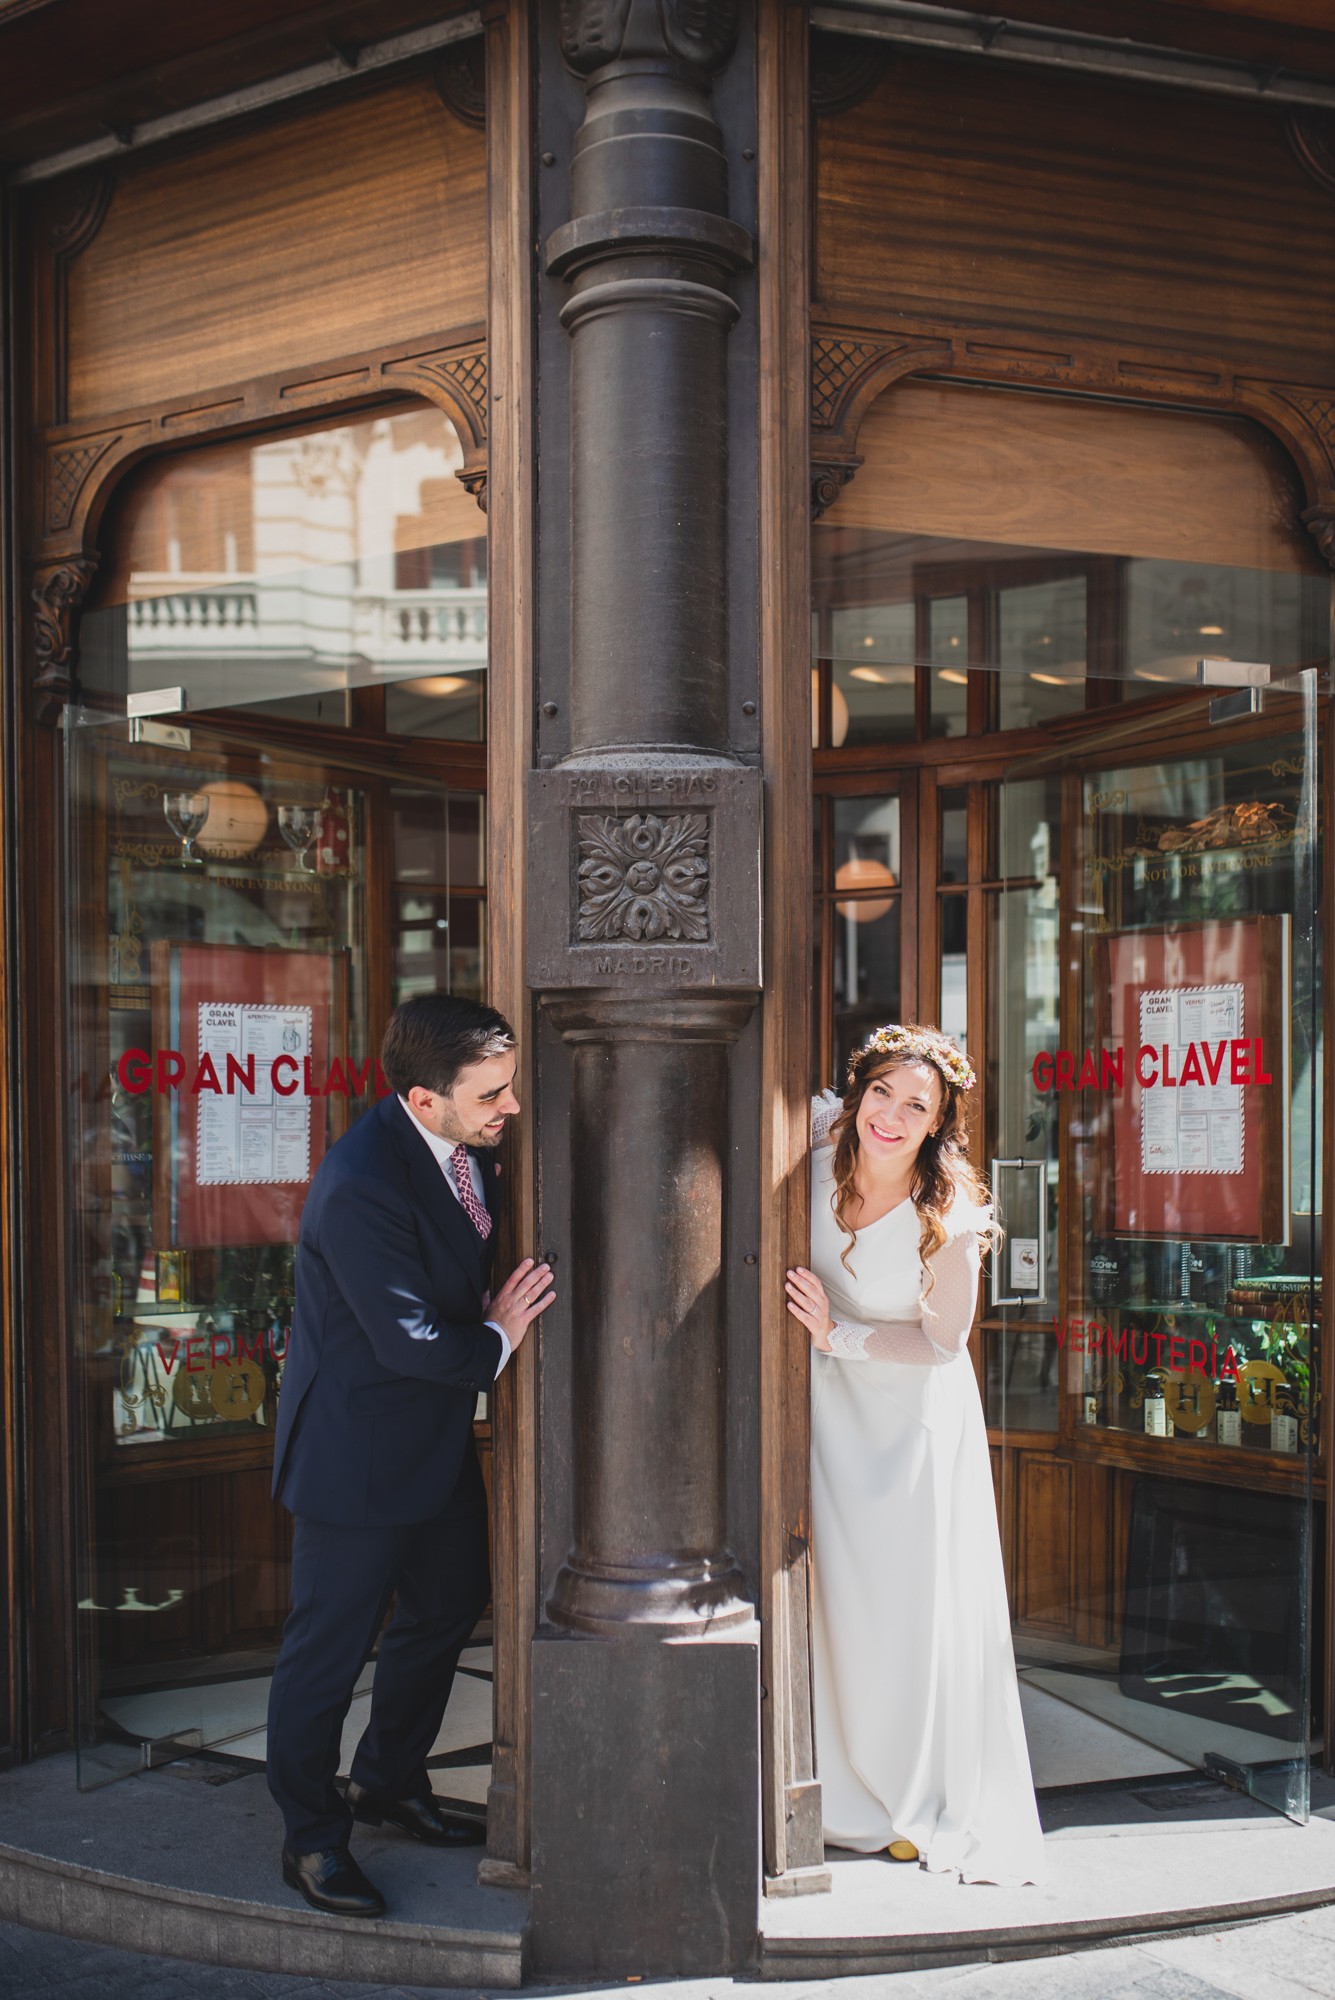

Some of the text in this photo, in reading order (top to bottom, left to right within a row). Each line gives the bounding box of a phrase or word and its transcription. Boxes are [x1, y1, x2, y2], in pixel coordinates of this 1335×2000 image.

[611, 776, 718, 793] IGLESIAS
[1141, 855, 1273, 882] NOT FOR EVERYONE
[216, 876, 247, 889] FOR
[250, 877, 321, 894] EVERYONE
[595, 956, 693, 976] MADRID
[1146, 1005, 1173, 1014] CLAVEL
[1149, 997, 1171, 1005] GRAN
[206, 1018, 237, 1027] CLAVEL
[209, 1010, 235, 1018] GRAN
[118, 1048, 393, 1097] GRAN CLAVE
[1032, 1037, 1272, 1092] GRAN CLAVEL
[156, 1328, 290, 1376] VERMU
[1052, 1314, 1241, 1384] VERMUTERÍA
